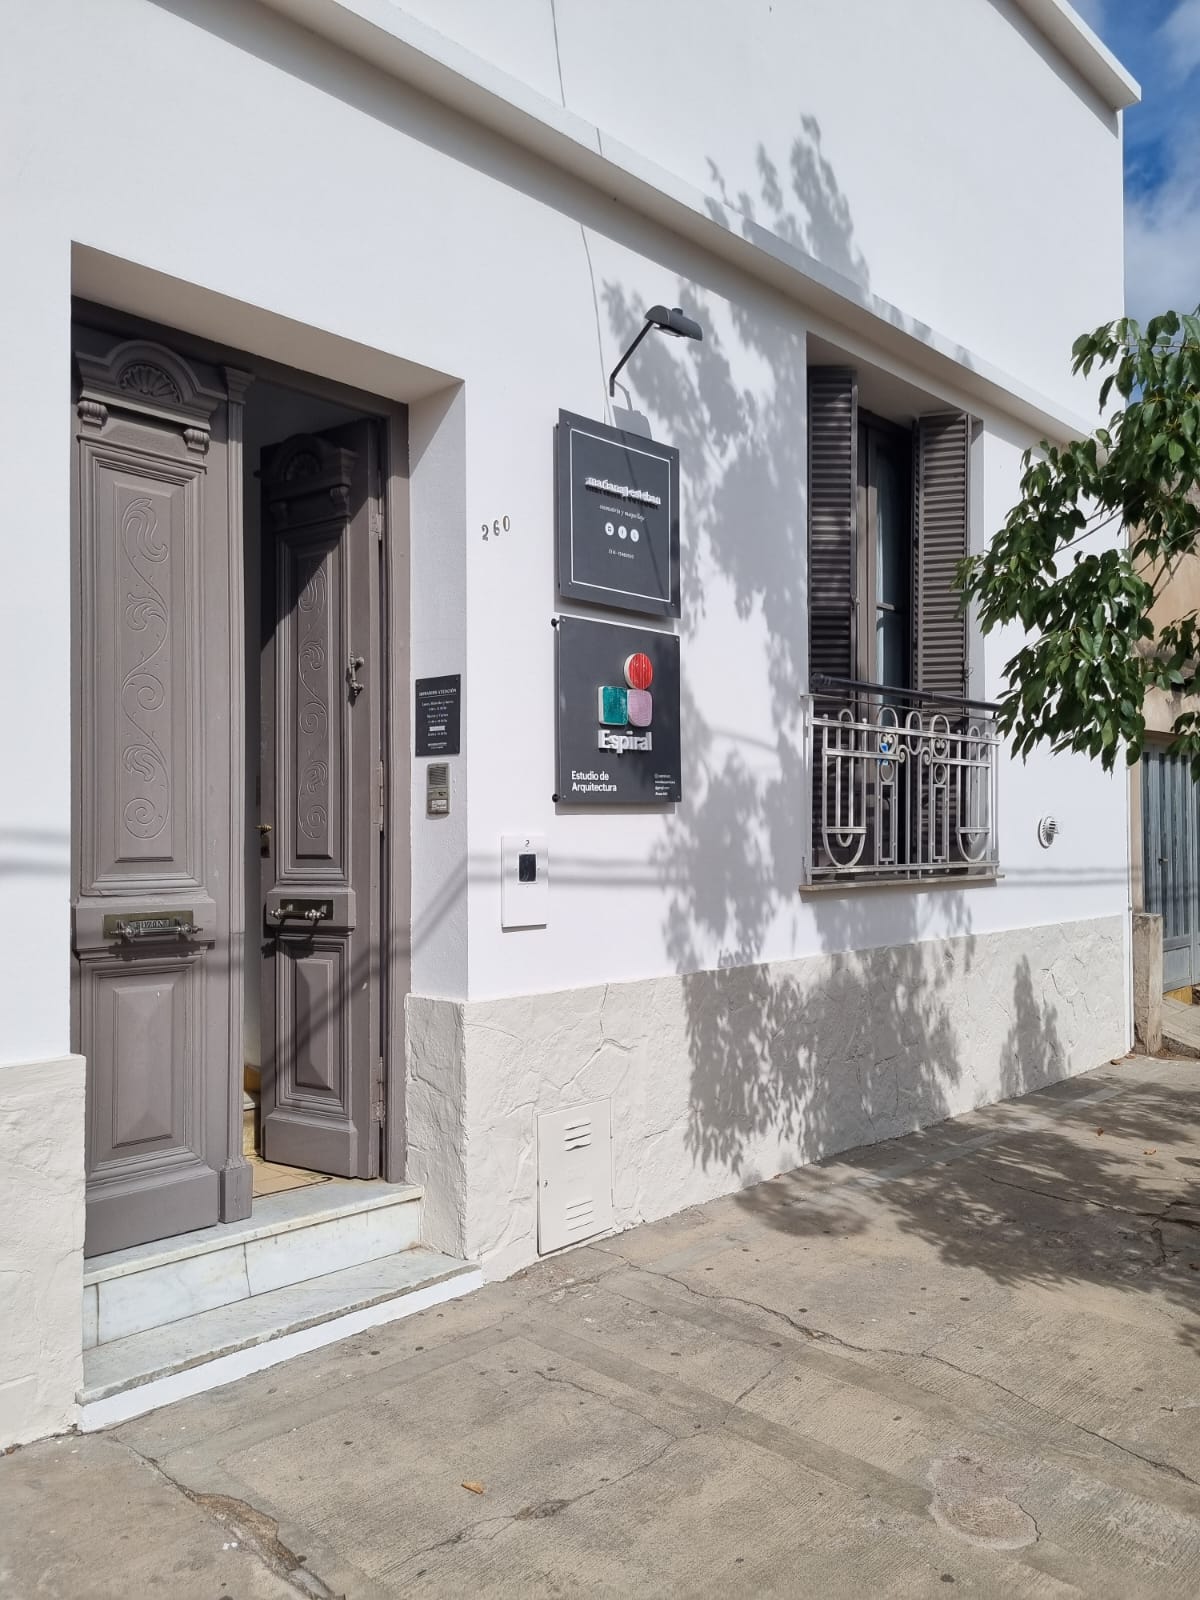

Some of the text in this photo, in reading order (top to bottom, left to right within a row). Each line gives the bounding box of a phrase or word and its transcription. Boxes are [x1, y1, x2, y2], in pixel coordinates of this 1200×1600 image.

[481, 515, 511, 541] 260
[598, 729, 652, 754] Espiral
[571, 770, 610, 781] Estudio de
[571, 781, 617, 794] Arquitectura
